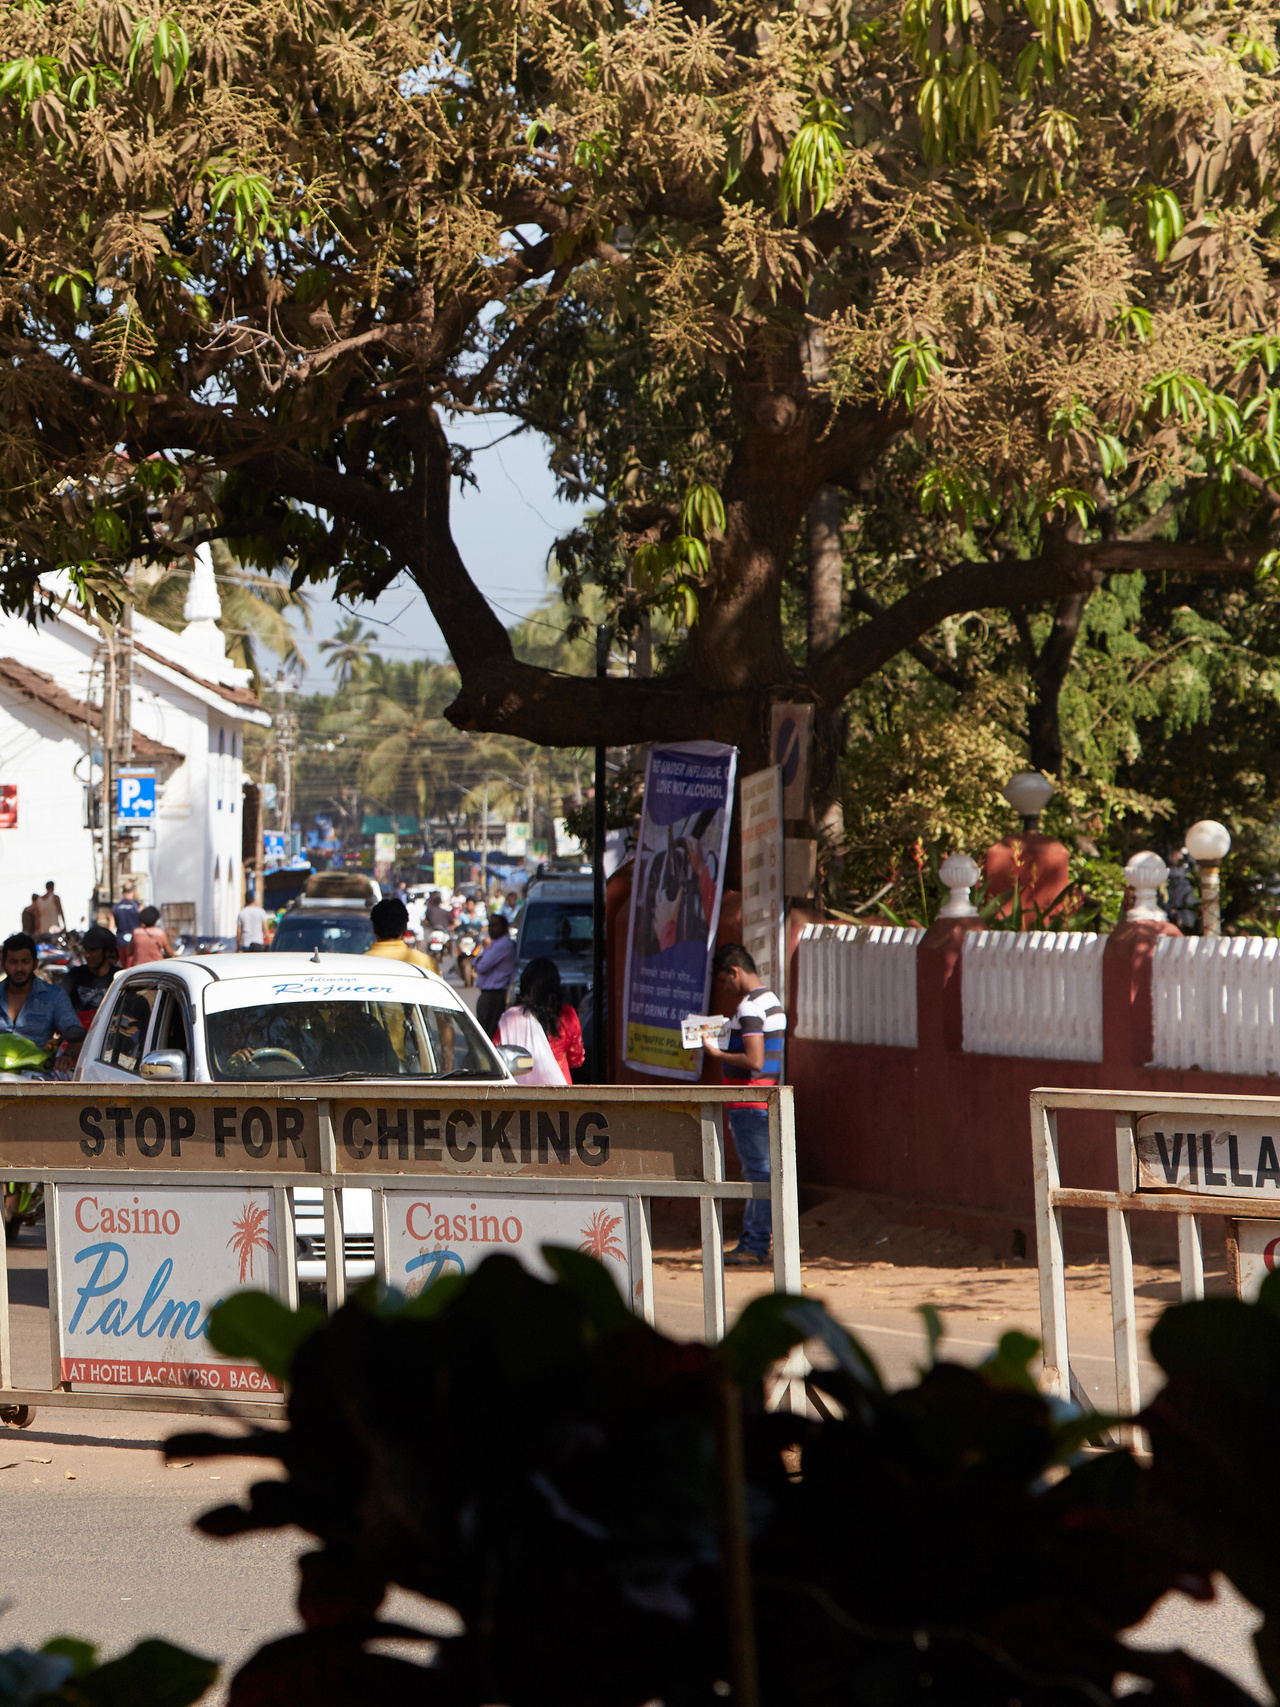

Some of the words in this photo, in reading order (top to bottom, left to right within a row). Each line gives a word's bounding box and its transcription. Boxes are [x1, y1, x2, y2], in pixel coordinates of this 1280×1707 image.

[661, 761, 686, 776] UNDER
[121, 778, 141, 808] P
[656, 780, 671, 793] LOVE
[672, 782, 686, 795] NOT
[686, 783, 724, 799] ALCOHOL
[645, 1004, 668, 1018] DRINK
[670, 1009, 677, 1020] &
[79, 1106, 196, 1158] STOP
[213, 1106, 306, 1160] FOR
[342, 1107, 610, 1167] CHECKING
[1154, 1132, 1280, 1188] VILLA
[75, 1196, 180, 1236] Casino
[406, 1202, 523, 1243] Casino
[69, 1363, 86, 1380] AT
[90, 1364, 133, 1383] HOTEL
[229, 1372, 272, 1390] BAGA
